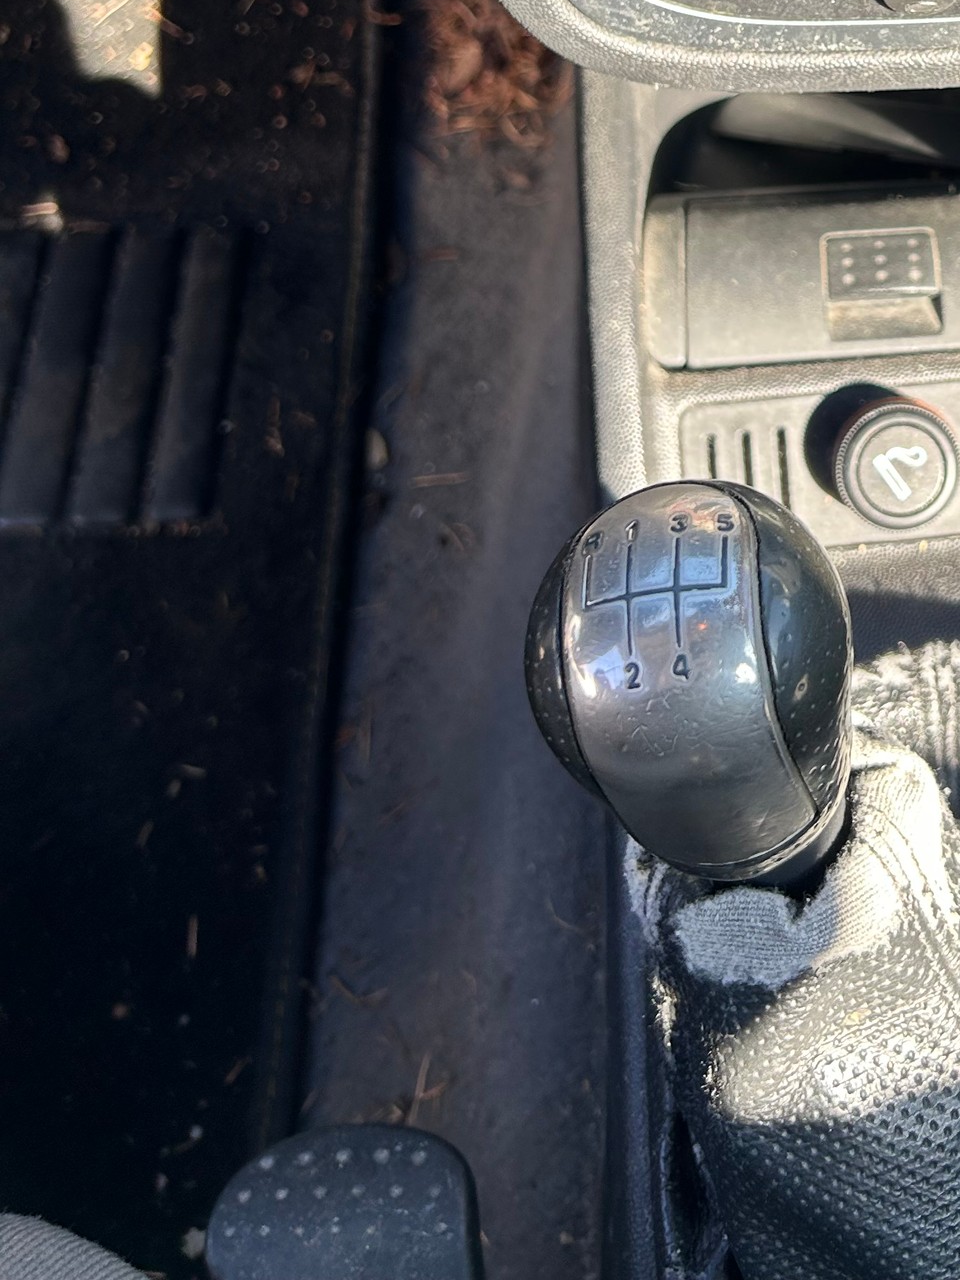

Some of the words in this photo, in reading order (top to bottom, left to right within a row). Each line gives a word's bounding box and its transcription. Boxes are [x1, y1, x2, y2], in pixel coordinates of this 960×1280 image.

[625, 519, 639, 541] 1
[670, 513, 689, 533] 3
[716, 513, 735, 532] 5
[624, 662, 641, 690] 2
[672, 653, 690, 680] 4
